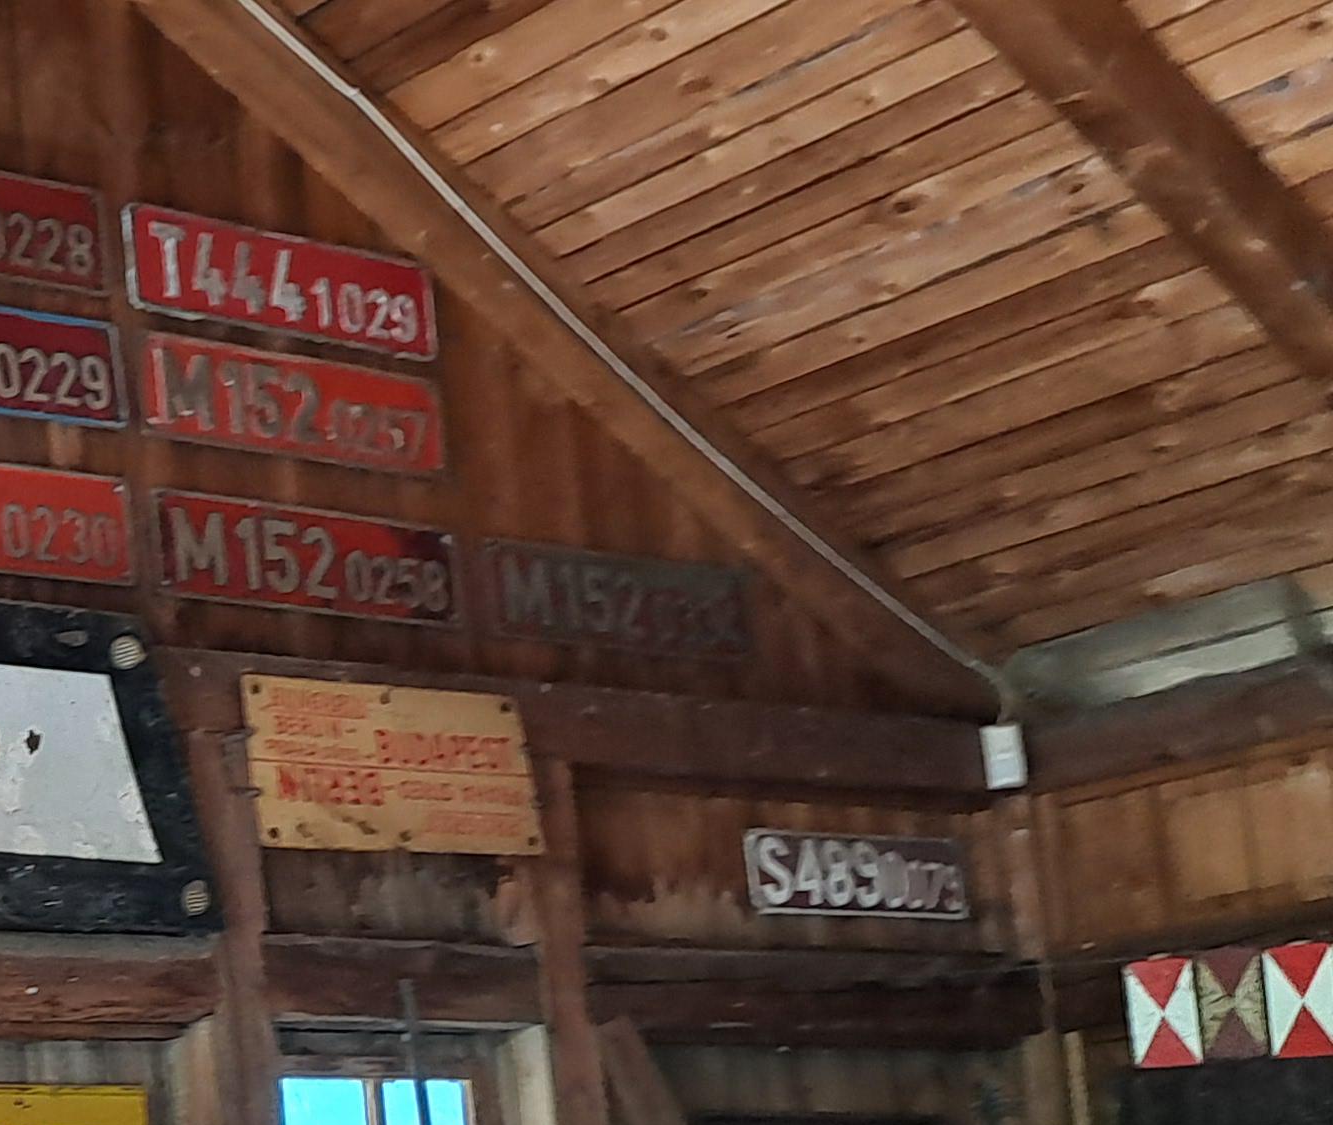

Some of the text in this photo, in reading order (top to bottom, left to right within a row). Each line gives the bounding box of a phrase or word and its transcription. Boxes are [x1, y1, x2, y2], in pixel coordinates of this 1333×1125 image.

[147, 220, 419, 344] T444 1029
[149, 347, 325, 441] M152
[1, 502, 120, 567] 0230
[169, 506, 339, 599] M152
